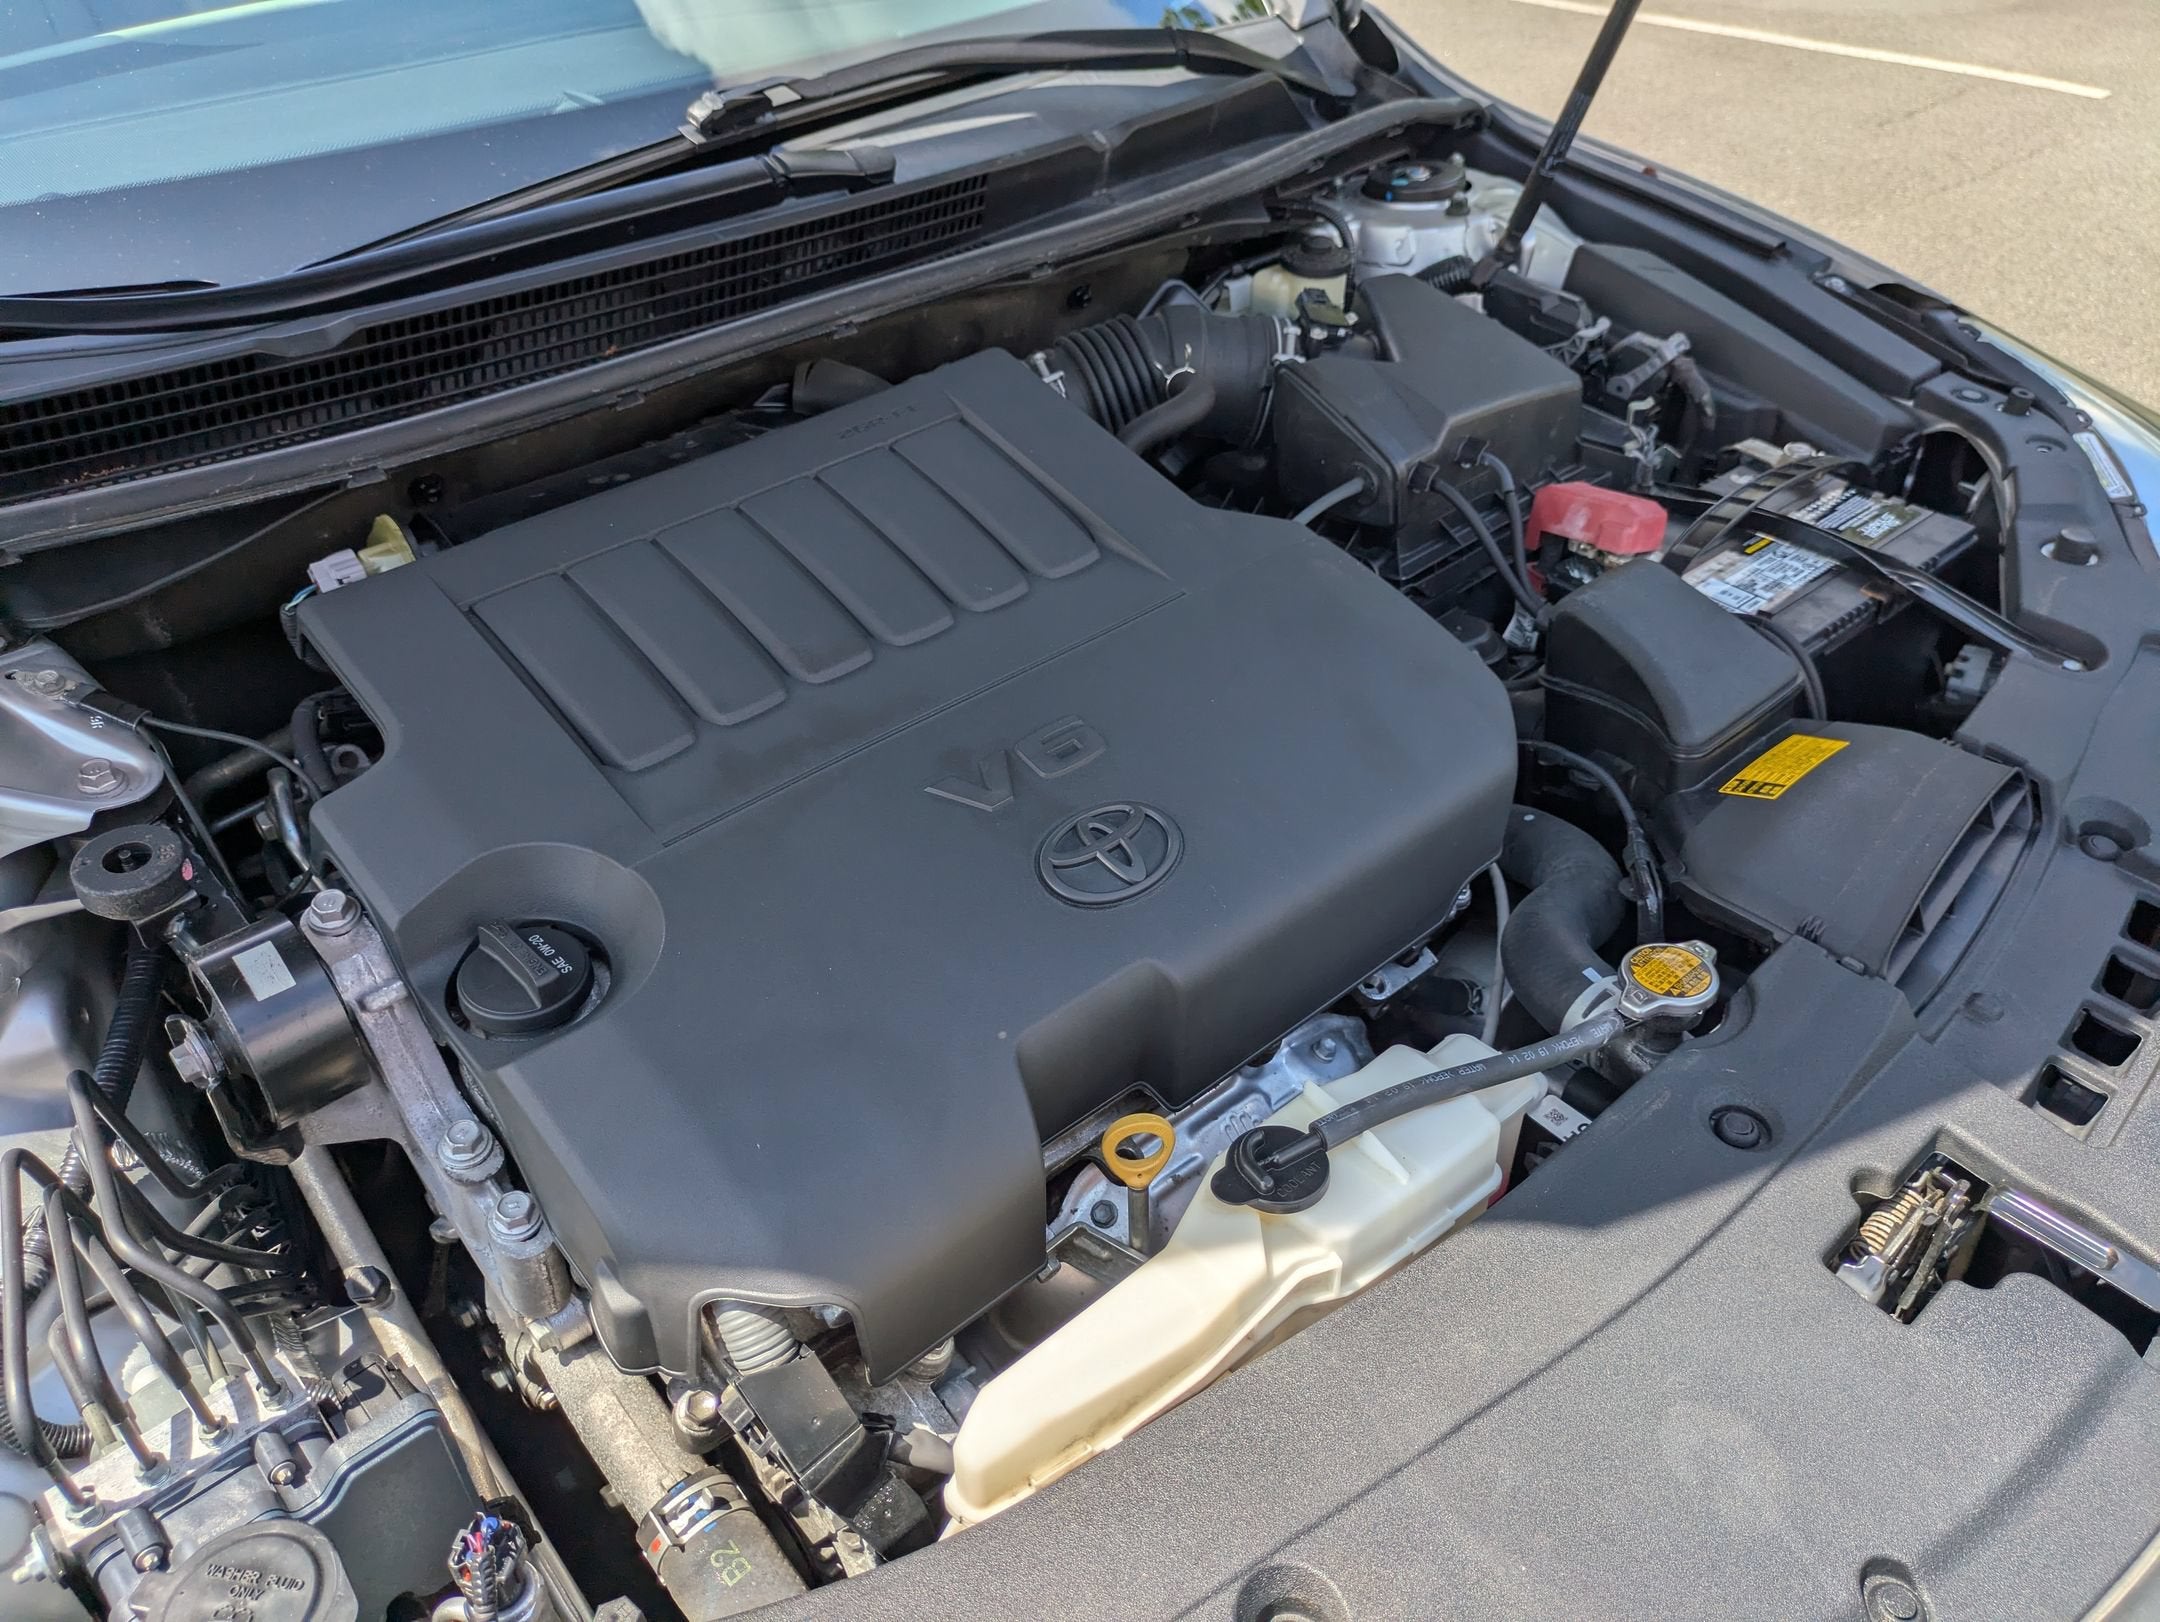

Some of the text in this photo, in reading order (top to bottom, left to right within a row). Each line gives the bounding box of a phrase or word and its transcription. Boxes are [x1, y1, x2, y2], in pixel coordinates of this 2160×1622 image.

[924, 714, 1109, 812] V6
[551, 956, 573, 974] SAE
[1458, 1063, 1487, 1077] WATER
[1277, 1160, 1321, 1197] COOLANT
[205, 1563, 306, 1592] WASHER FLUID
[711, 1539, 752, 1588] B2
[229, 1585, 266, 1601] ONLY
